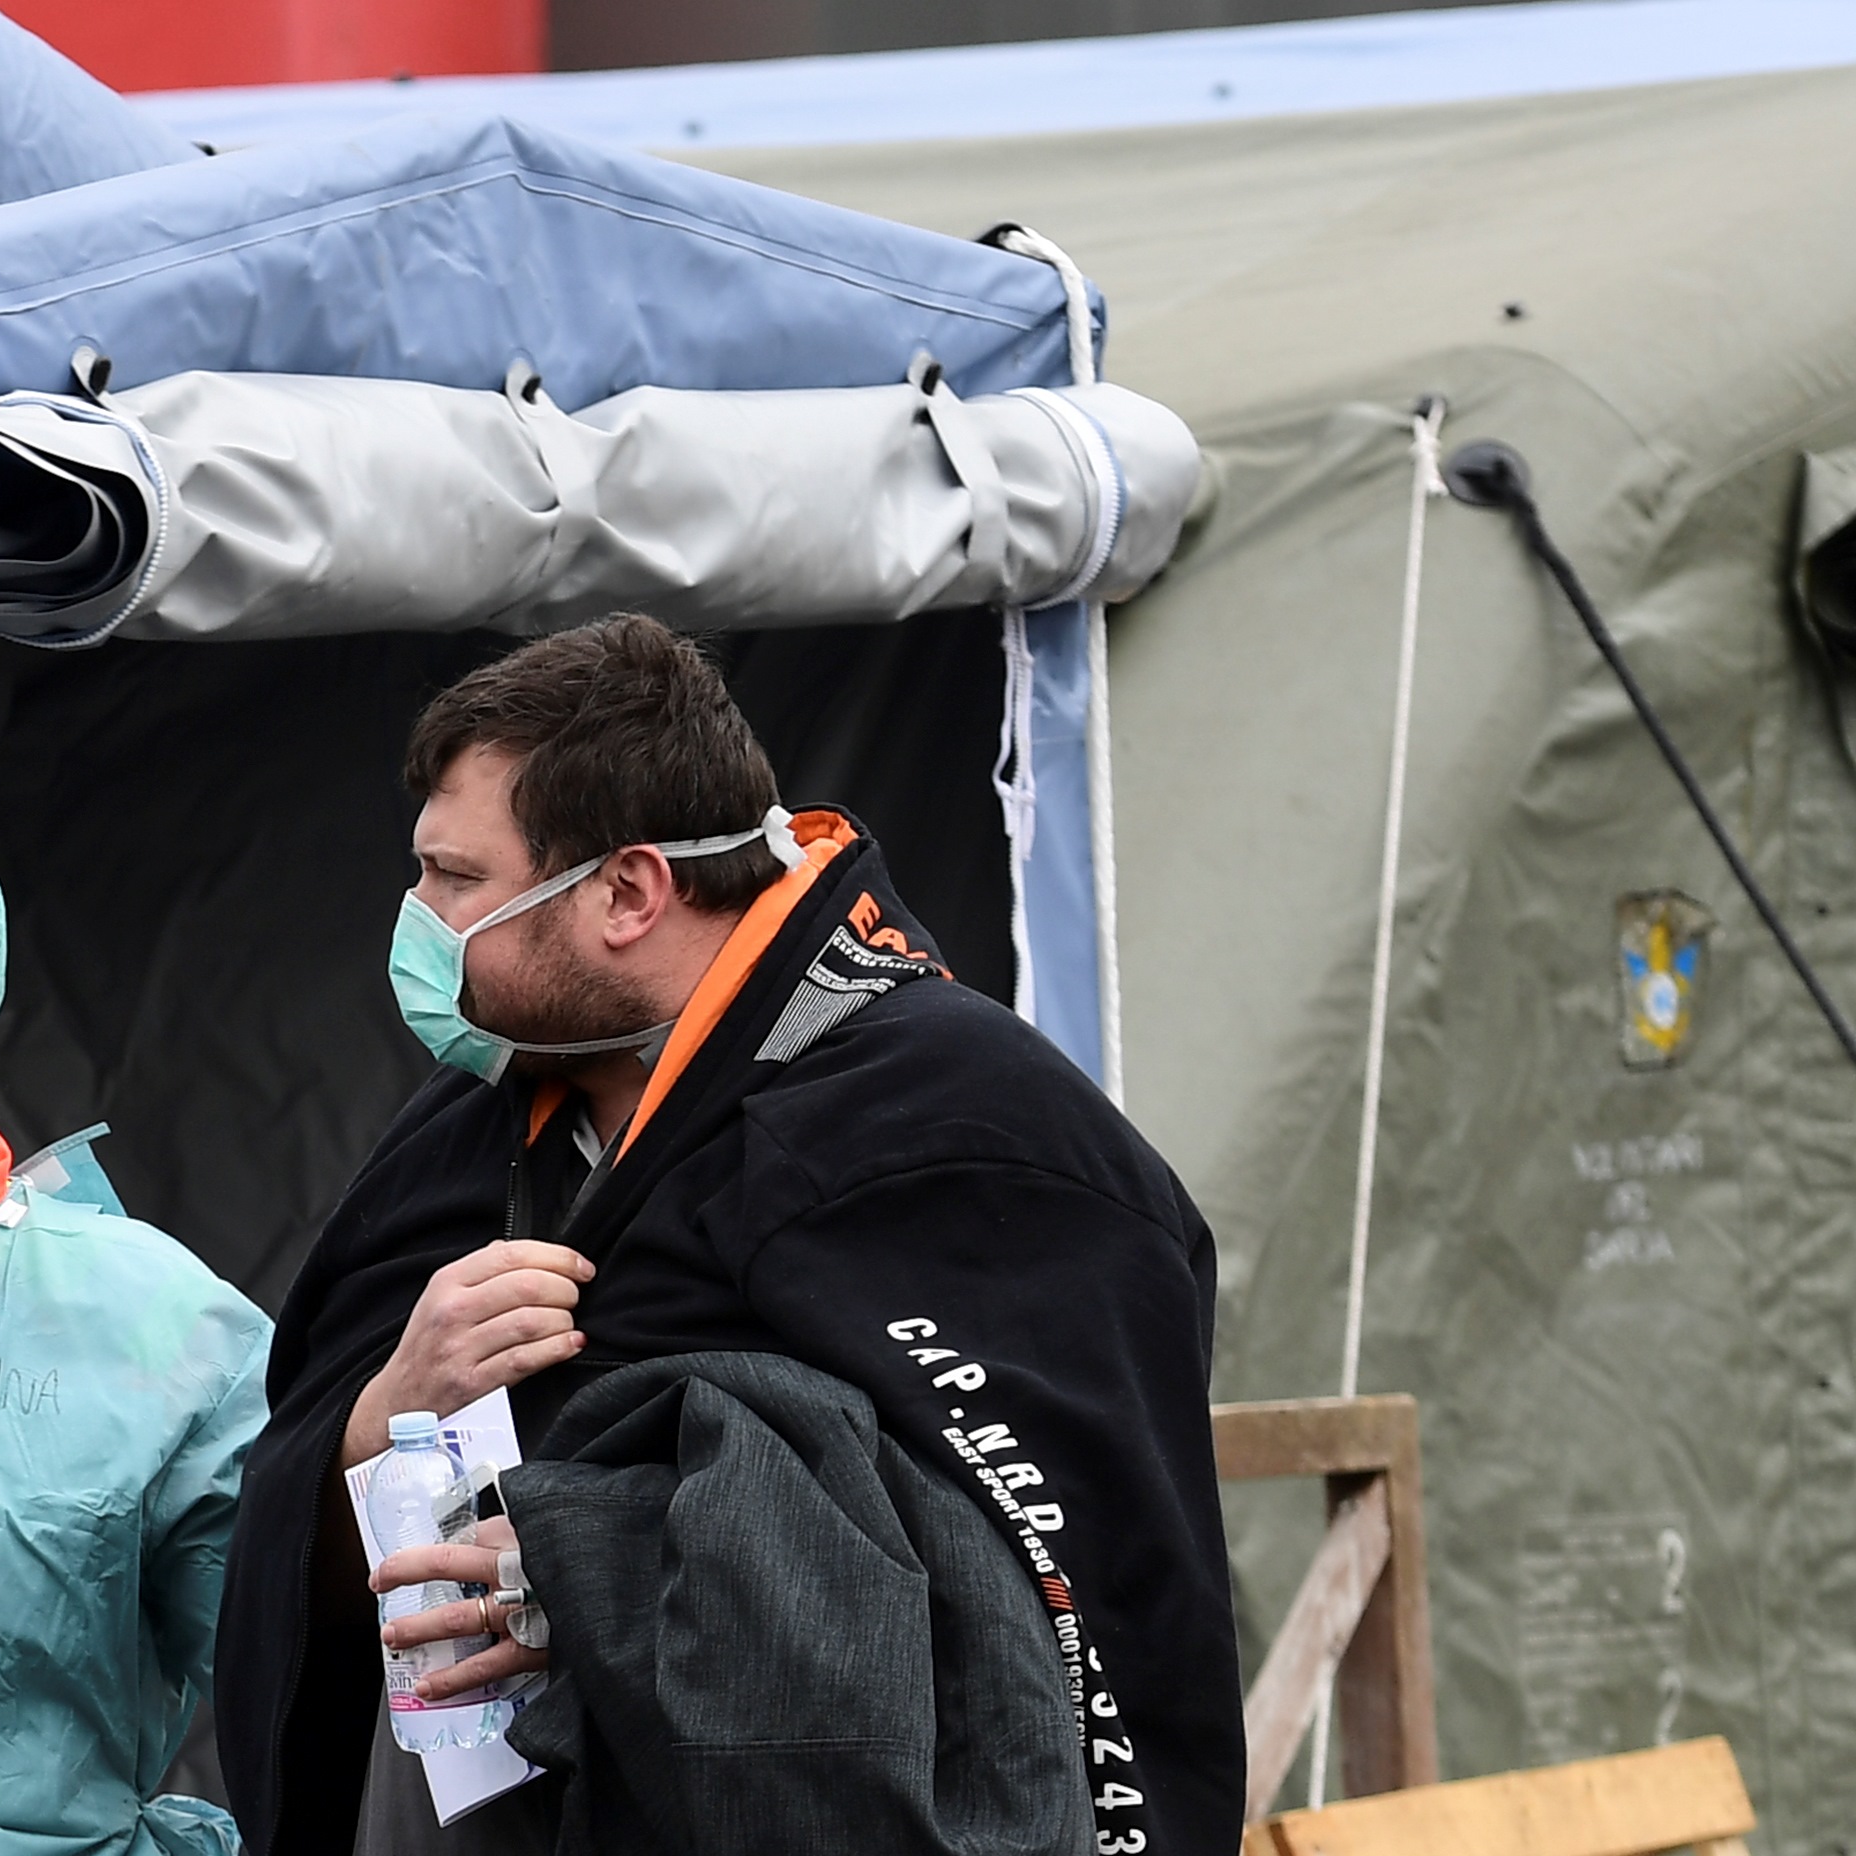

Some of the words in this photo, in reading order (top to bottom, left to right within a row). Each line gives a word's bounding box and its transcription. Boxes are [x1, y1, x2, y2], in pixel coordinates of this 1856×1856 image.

[941, 1427, 986, 1465] EASY
[976, 1467, 1028, 1528] SPORT
[1018, 1526, 1055, 1573] 1930
